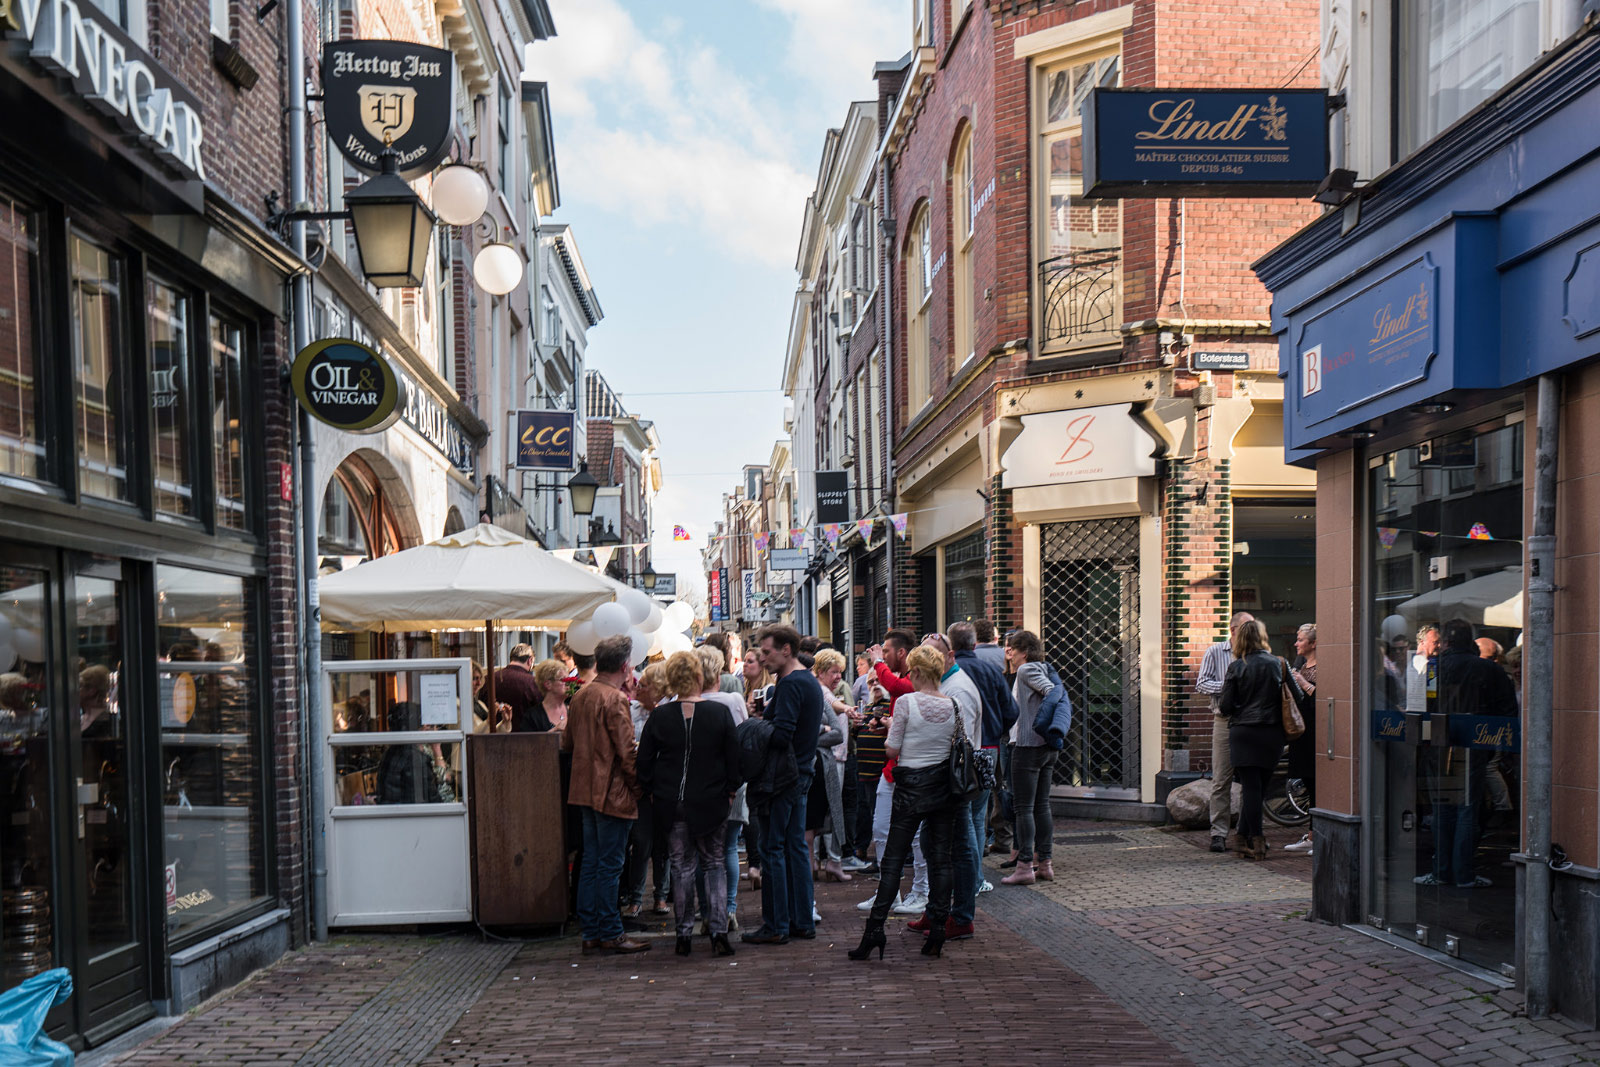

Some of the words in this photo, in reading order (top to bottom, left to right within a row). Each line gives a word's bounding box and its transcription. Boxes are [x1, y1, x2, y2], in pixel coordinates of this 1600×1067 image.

[333, 50, 401, 78] Hertog
[402, 55, 442, 81] Jan
[1135, 98, 1259, 141] Lindt
[346, 133, 378, 164] Witte
[397, 145, 428, 165] lons
[1135, 152, 1176, 163] MAÎTRE
[1178, 153, 1251, 163] CHOCOLATIER
[1253, 153, 1290, 163] SUISSE
[1181, 164, 1220, 174] DEPUIS
[1221, 165, 1244, 174] 1845
[1369, 294, 1416, 346] Lindt
[1200, 353, 1246, 363] Boterstraat
[312, 391, 379, 405] VINEGAR
[521, 425, 570, 446] LCC
[1472, 723, 1505, 745] Lindt
